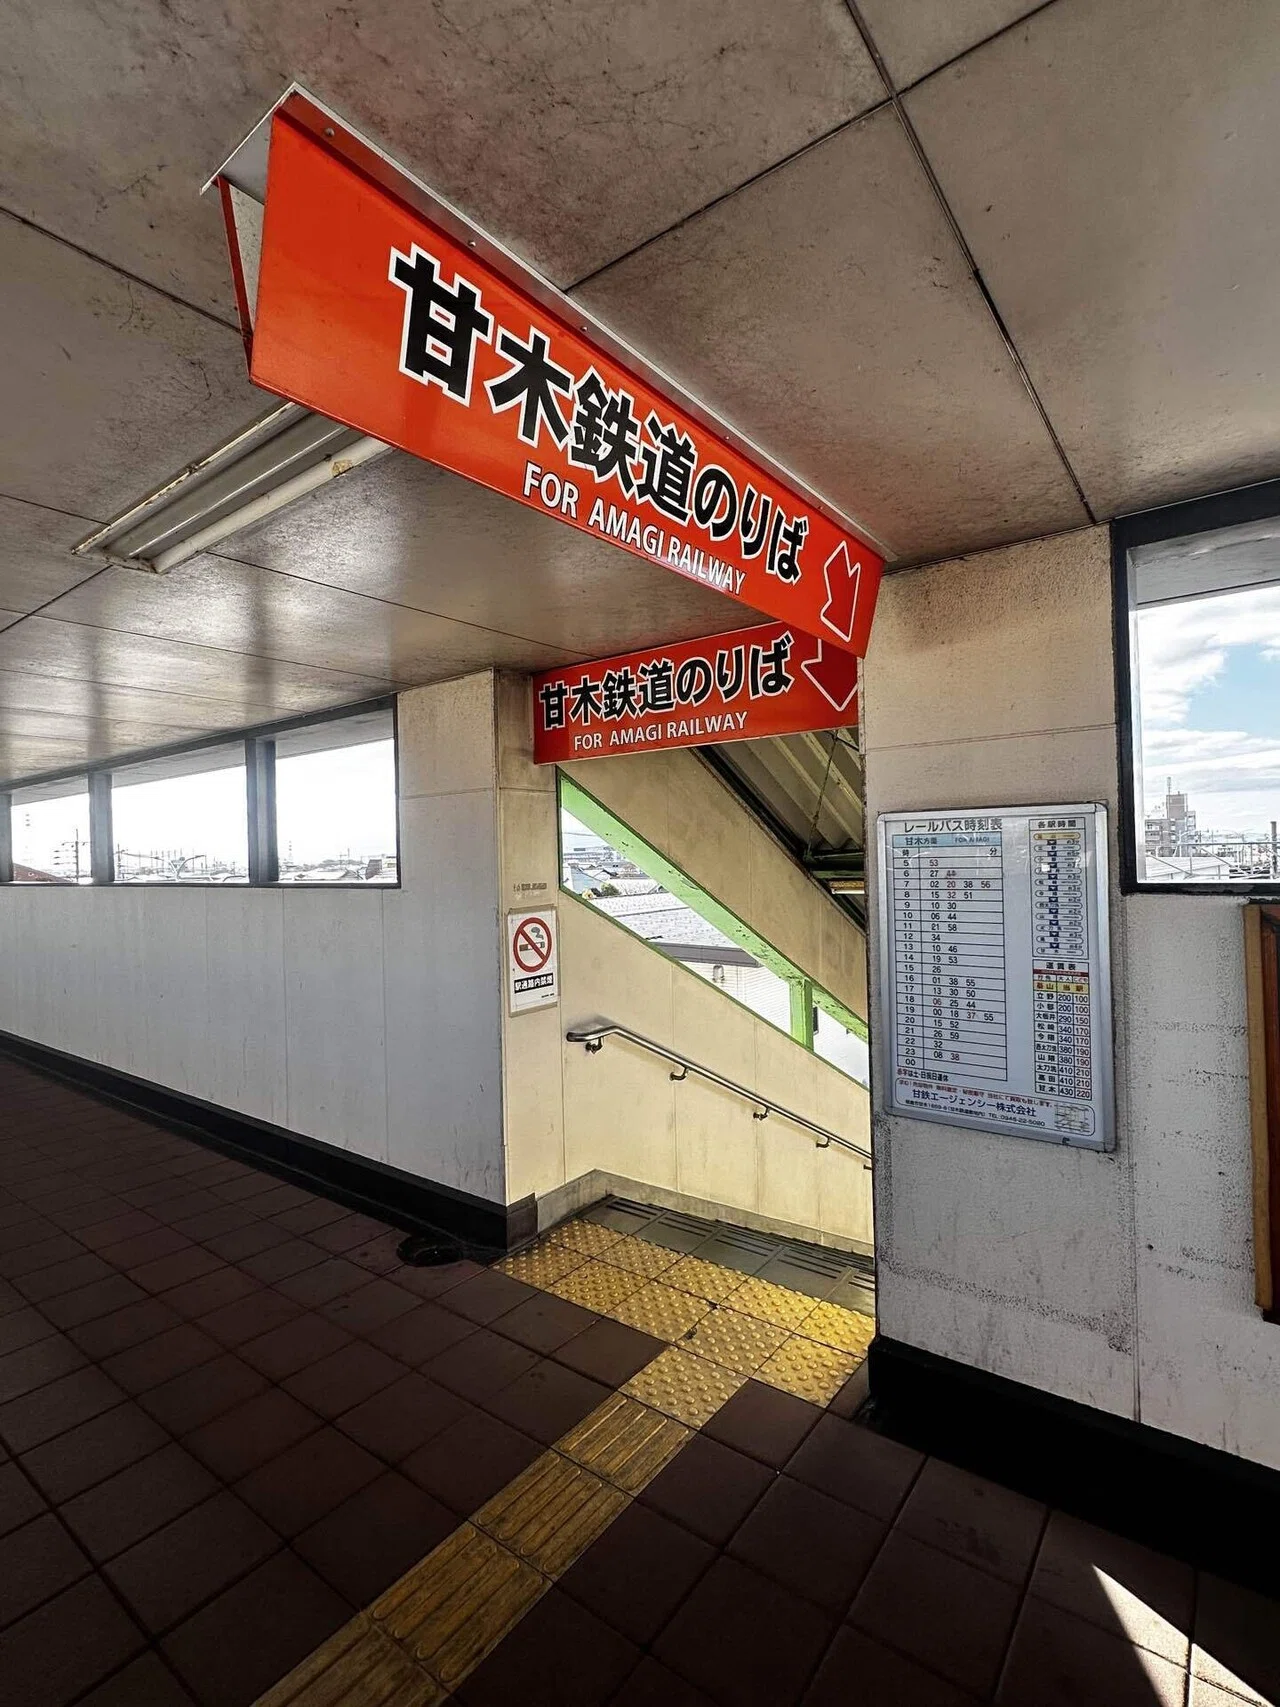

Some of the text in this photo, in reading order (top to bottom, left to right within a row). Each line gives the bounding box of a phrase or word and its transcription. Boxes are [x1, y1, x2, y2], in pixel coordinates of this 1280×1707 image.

[388, 242, 808, 584] 甘木鉄道のりば
[523, 461, 747, 596] FOR AMAGI RAILWAY
[538, 630, 793, 731] 甘木鉄道のりば
[574, 711, 748, 751] FOR AMAGI RAILWAY
[904, 819, 1002, 833] レールバス時刻表
[949, 956, 957, 964] 53
[933, 987, 941, 995] 13
[984, 1013, 993, 1021] 55
[934, 1019, 942, 1027] 15
[1076, 1048, 1089, 1056] 190
[1060, 1056, 1072, 1064] 380
[1076, 1069, 1089, 1077] 210
[1060, 1077, 1073, 1085] 410
[1077, 1079, 1089, 1087] 210
[1060, 1087, 1073, 1095] 430
[1077, 1090, 1090, 1098] 220
[912, 1089, 1037, 1117] 甘鉄エージェンシー株式会社
